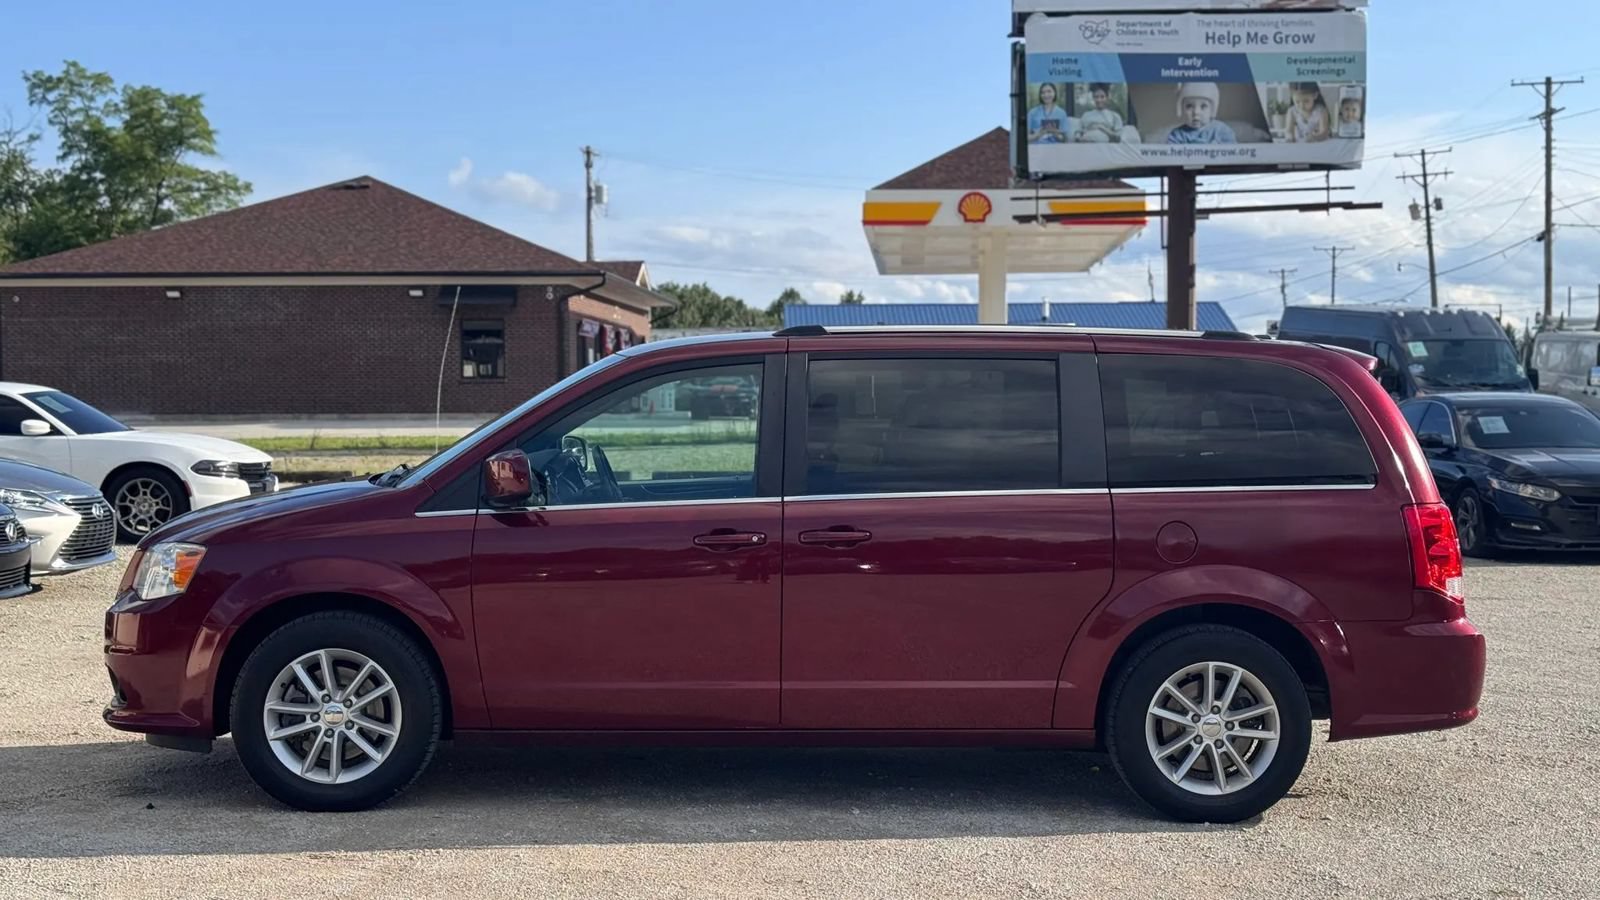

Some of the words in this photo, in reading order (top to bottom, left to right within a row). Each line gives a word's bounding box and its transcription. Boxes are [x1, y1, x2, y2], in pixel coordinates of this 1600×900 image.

[1116, 20, 1162, 30] Department
[1163, 20, 1172, 28] of
[1197, 20, 1211, 28] The
[1214, 19, 1236, 28] heart
[1238, 19, 1246, 28] of
[1248, 19, 1280, 29] thriving
[1205, 31, 1241, 47] Help
[1246, 32, 1268, 45] Me
[1273, 32, 1315, 45] Grow
[1052, 57, 1078, 65] Home
[1178, 57, 1202, 68] Early
[1287, 56, 1356, 66] Developmental
[1048, 67, 1082, 77] Visiting
[1161, 68, 1219, 78] Intervention
[1296, 67, 1346, 77] Screenings
[1141, 146, 1257, 159] www.helpmegrow.org
